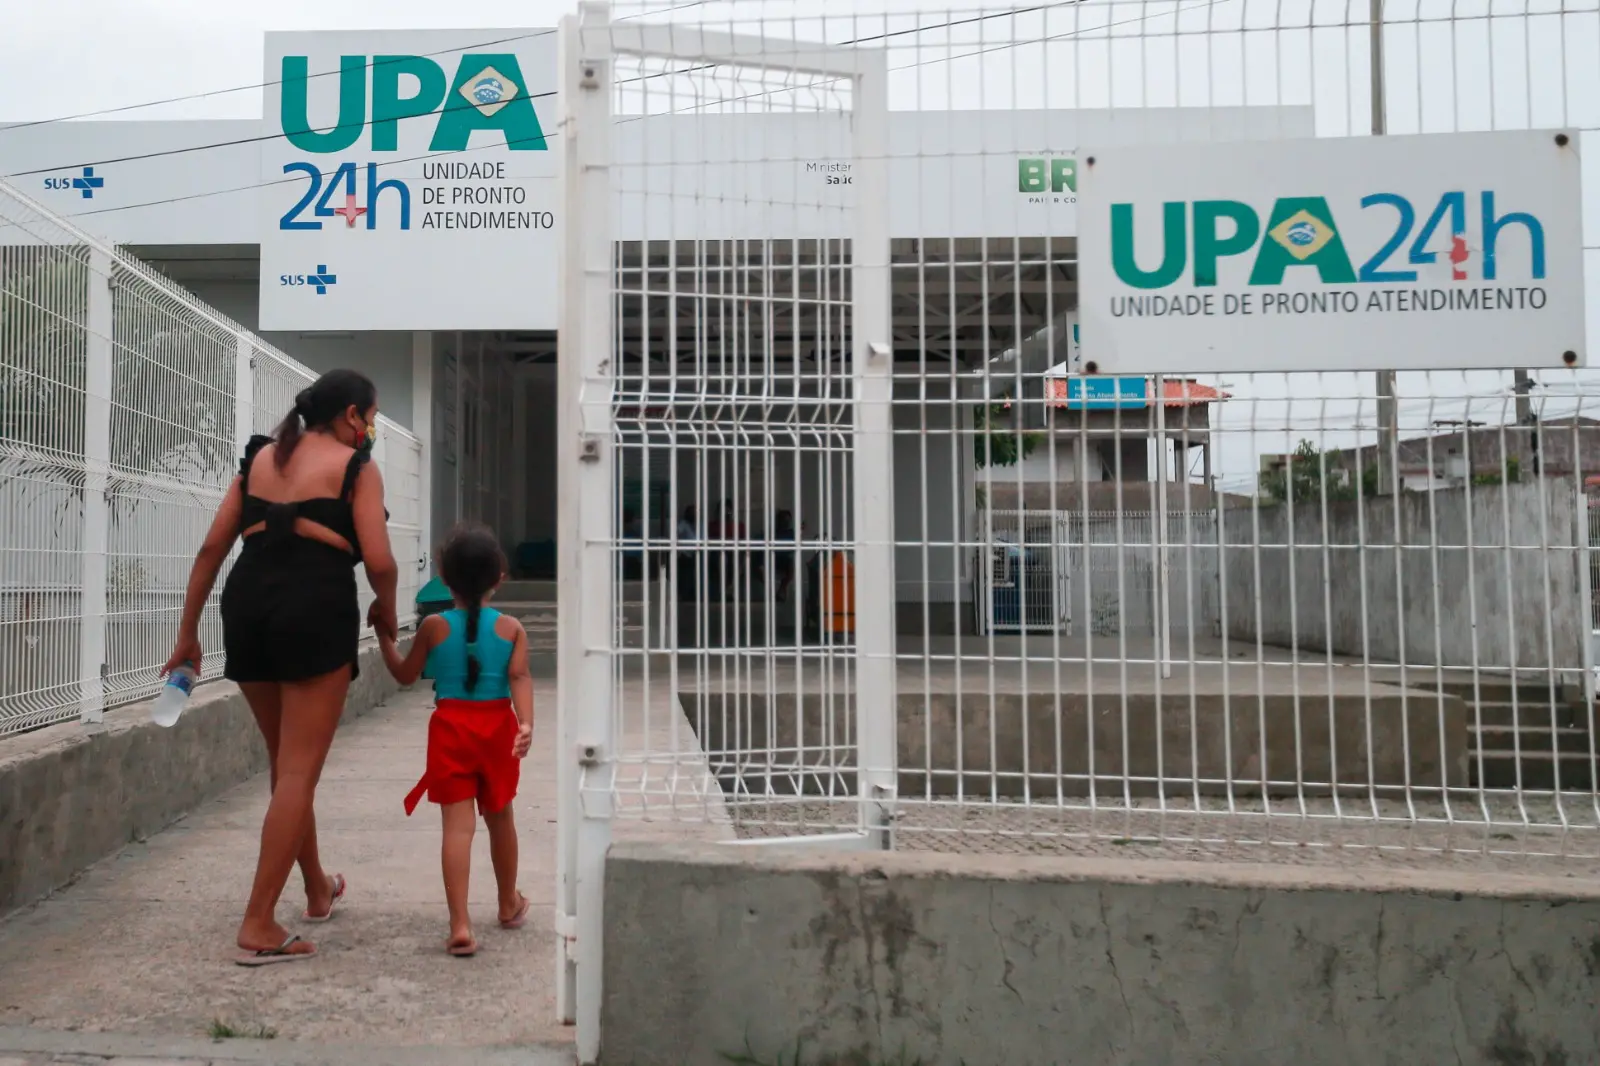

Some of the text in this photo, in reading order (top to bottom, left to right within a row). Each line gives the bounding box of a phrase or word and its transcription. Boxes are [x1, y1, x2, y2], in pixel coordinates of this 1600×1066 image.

[281, 54, 548, 153] UPA
[423, 162, 505, 180] UNIDADE
[44, 178, 70, 190] SUS
[280, 162, 411, 230] 24h
[423, 187, 526, 204] DE PRONTO
[422, 211, 554, 229] ATENDIMENTO
[1110, 190, 1545, 289] UPA 24h
[280, 274, 305, 286] SUS
[1110, 287, 1547, 317] UNIDADE DE PRONTO ATENDIMENTO
